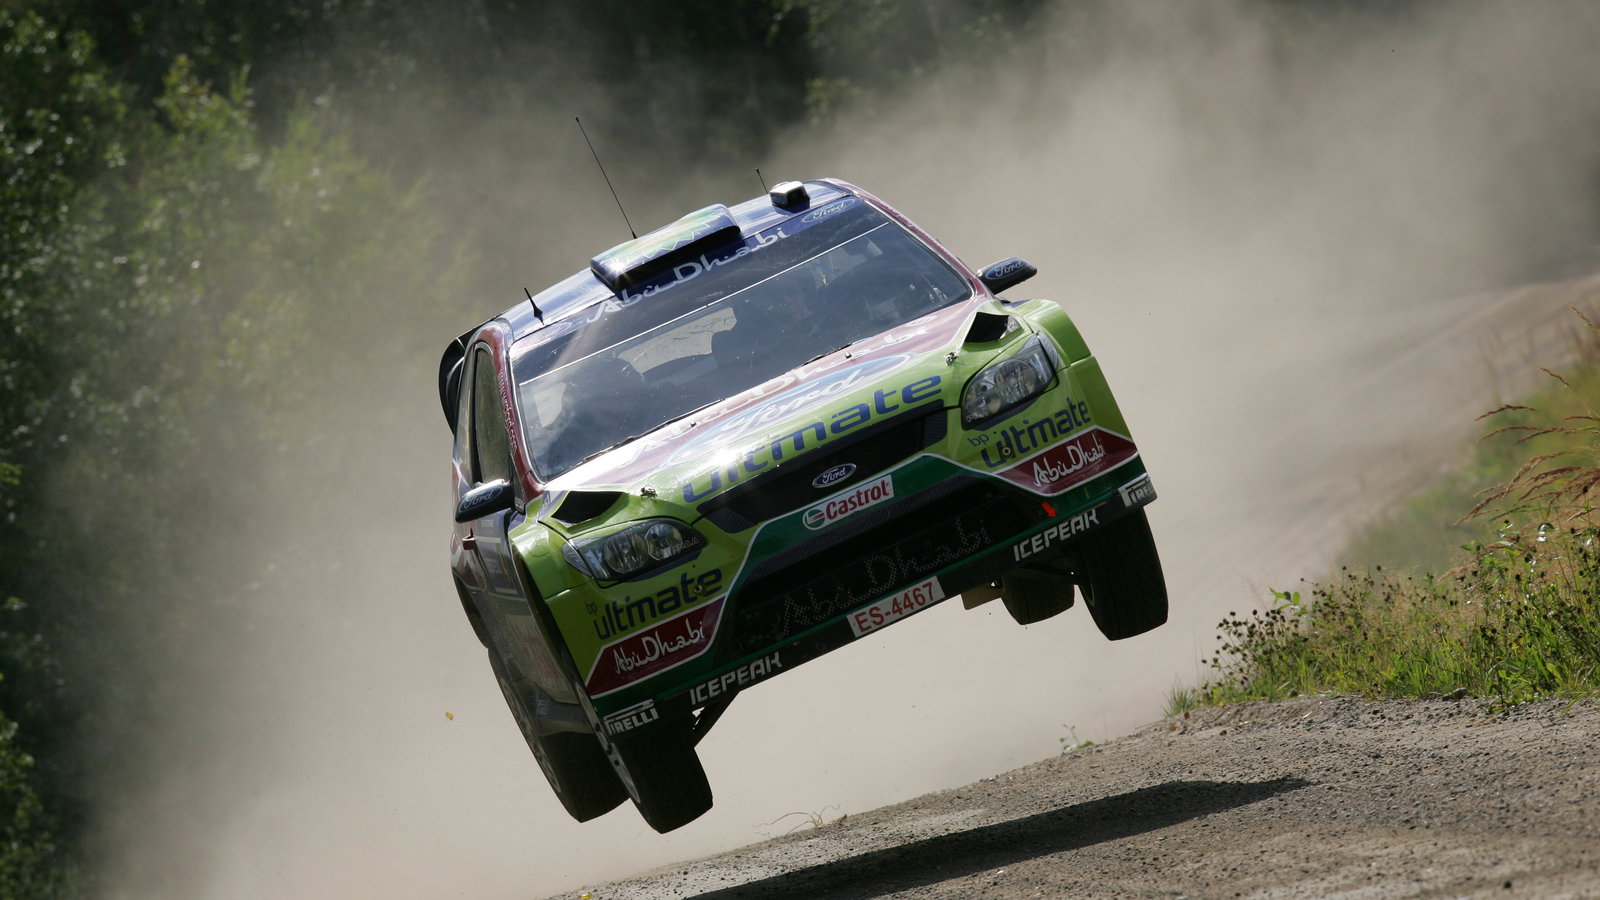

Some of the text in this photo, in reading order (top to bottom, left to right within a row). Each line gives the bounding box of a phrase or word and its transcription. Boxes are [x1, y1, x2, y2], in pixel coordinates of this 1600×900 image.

[811, 200, 848, 220] Ford
[587, 227, 790, 324] Abu Dhabi
[995, 259, 1026, 279] Ford
[720, 368, 866, 436] Ford
[967, 397, 1092, 468] bp ultimate
[822, 466, 847, 484] Ford
[1033, 456, 1073, 487] Abu
[463, 489, 497, 510] Ford
[826, 480, 890, 520] Castrol
[865, 515, 993, 593] Dhabi
[1013, 507, 1100, 562] ICEPEAK
[593, 568, 722, 640] ultimate
[853, 580, 936, 633] ES-4467
[613, 618, 705, 675] Abu Dhabi
[689, 652, 783, 705] ICEPEAK
[603, 699, 659, 736] PIRELLI
